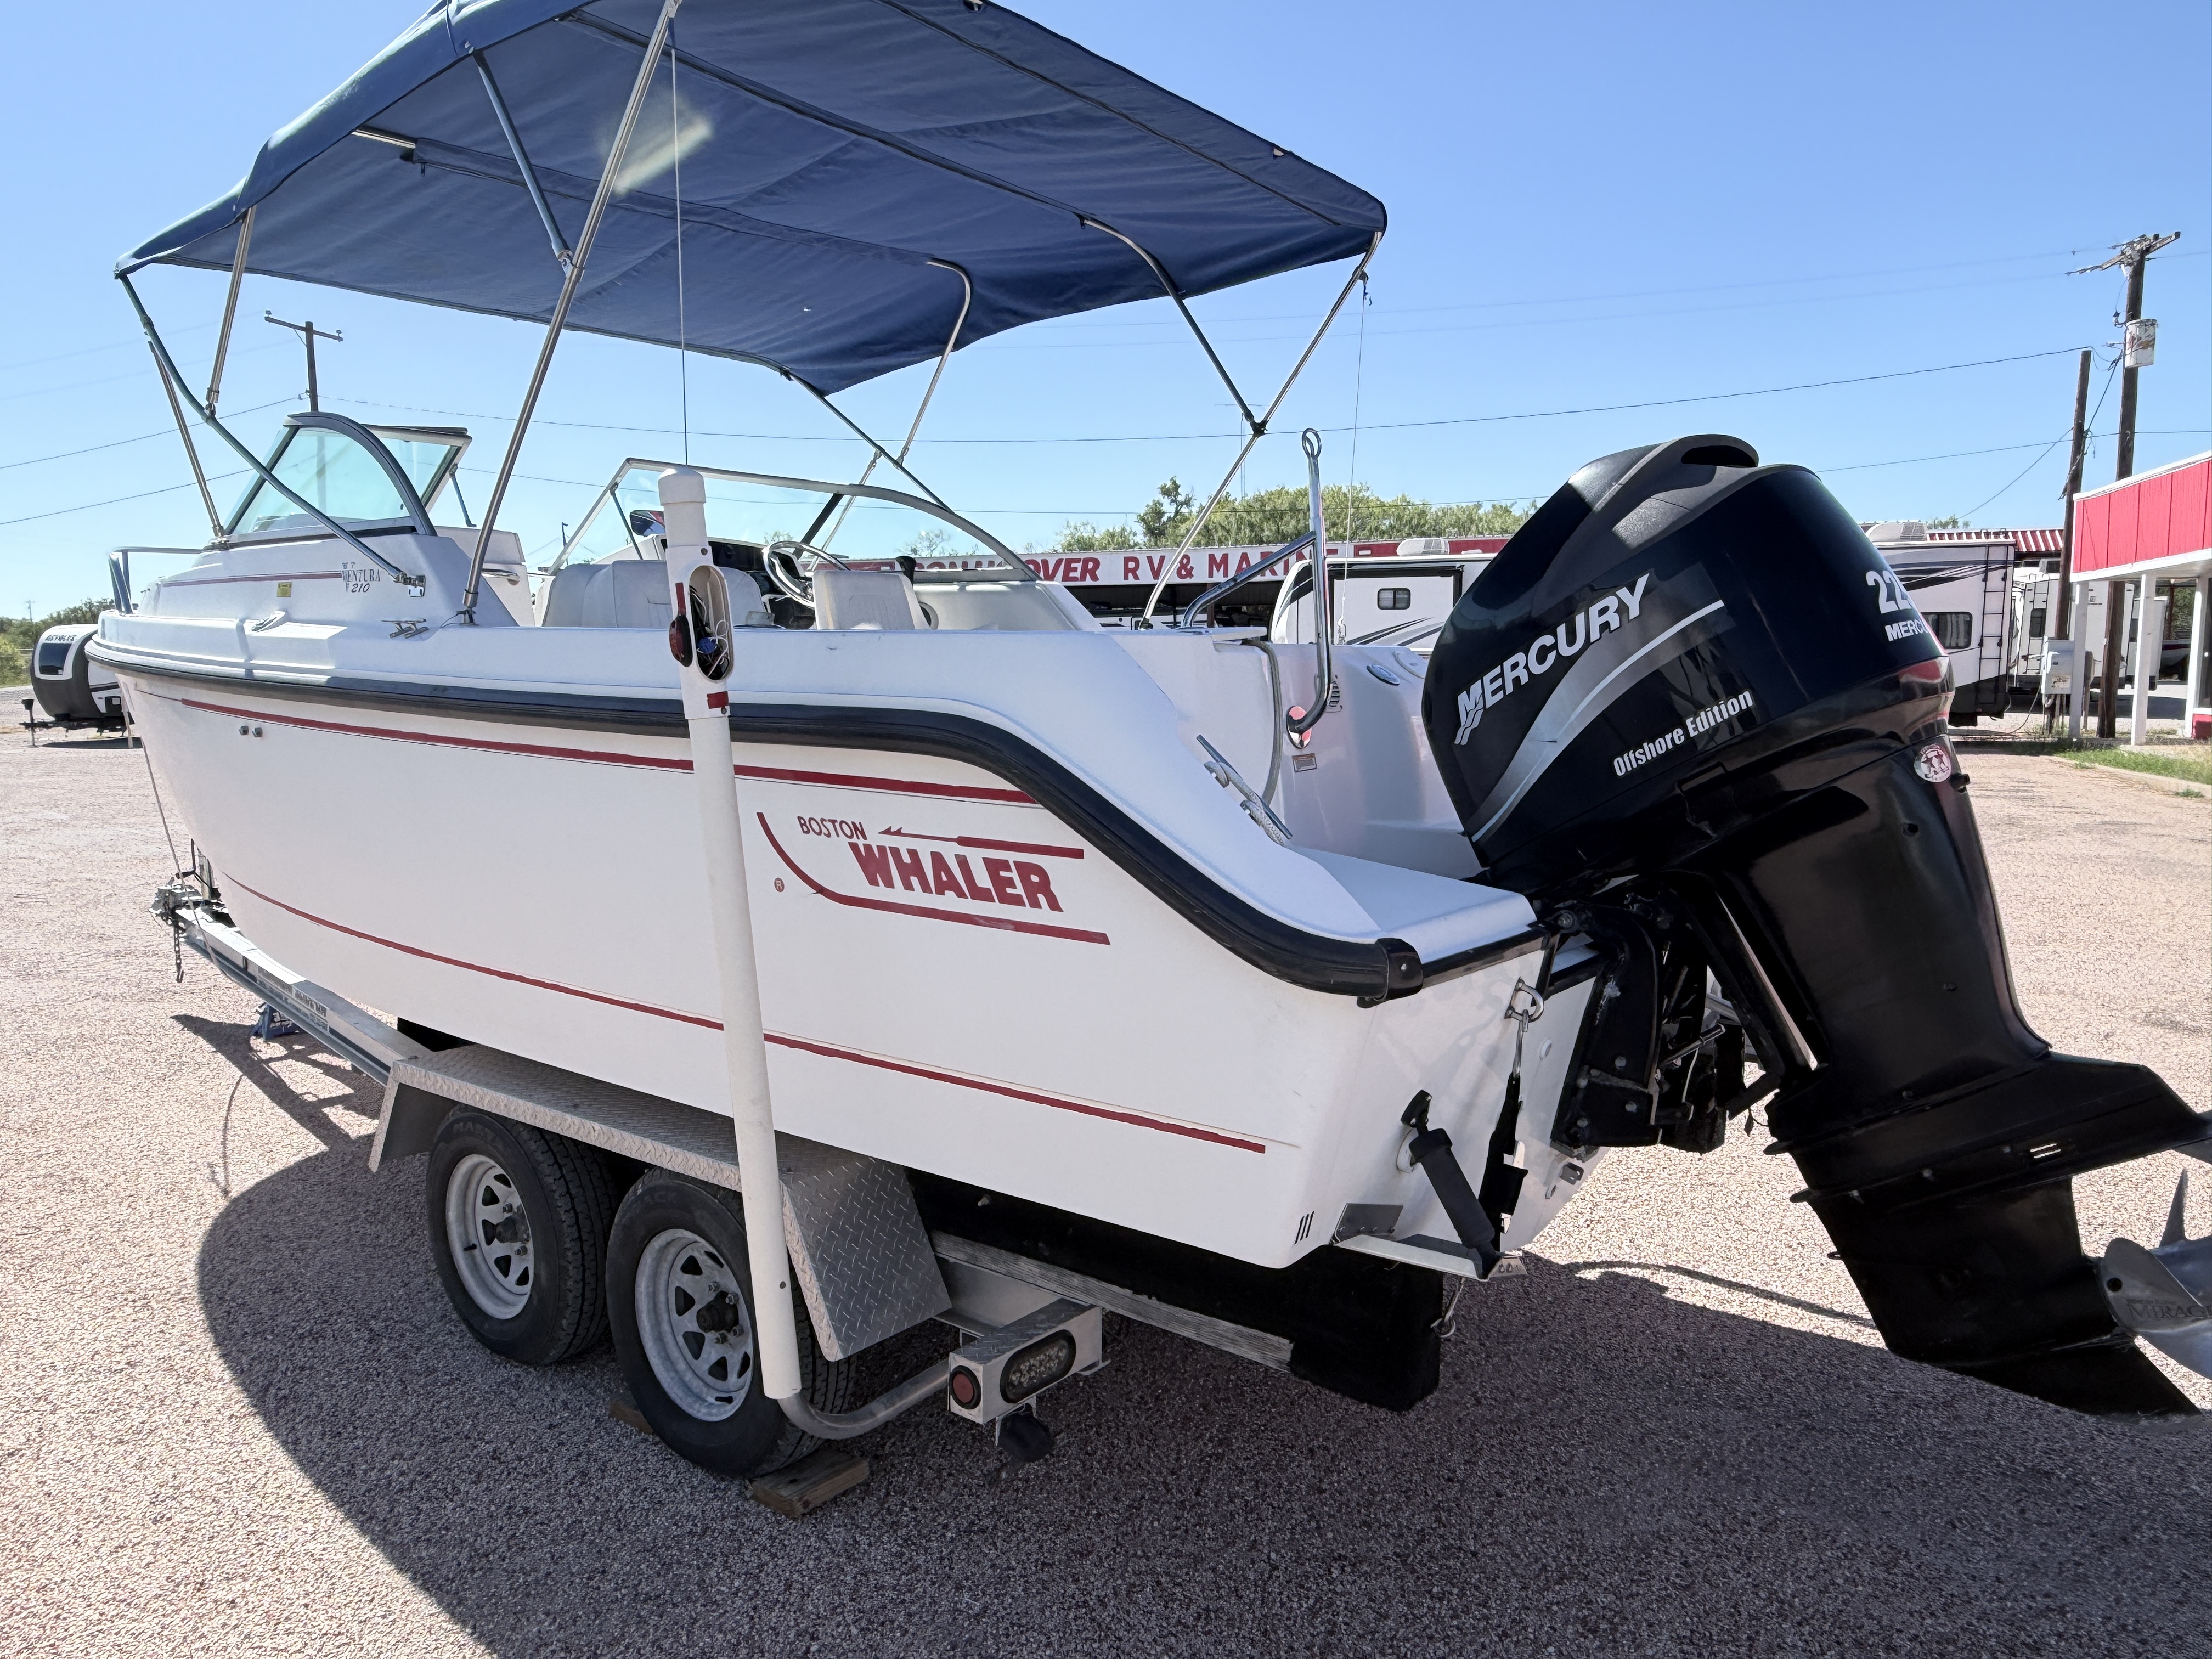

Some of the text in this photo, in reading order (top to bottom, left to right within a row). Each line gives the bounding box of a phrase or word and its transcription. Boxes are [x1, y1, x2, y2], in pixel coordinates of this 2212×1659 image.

[342, 562, 380, 592] VENTURA
[1123, 555, 1166, 580] RV
[1176, 554, 1194, 579] &
[351, 583, 370, 592] 210
[1866, 571, 1914, 614] 22
[1454, 573, 1650, 745] MERCURY
[1613, 690, 1754, 777] Offshore Edition
[797, 816, 867, 841] BOSTON
[848, 841, 1064, 912] WHALER
